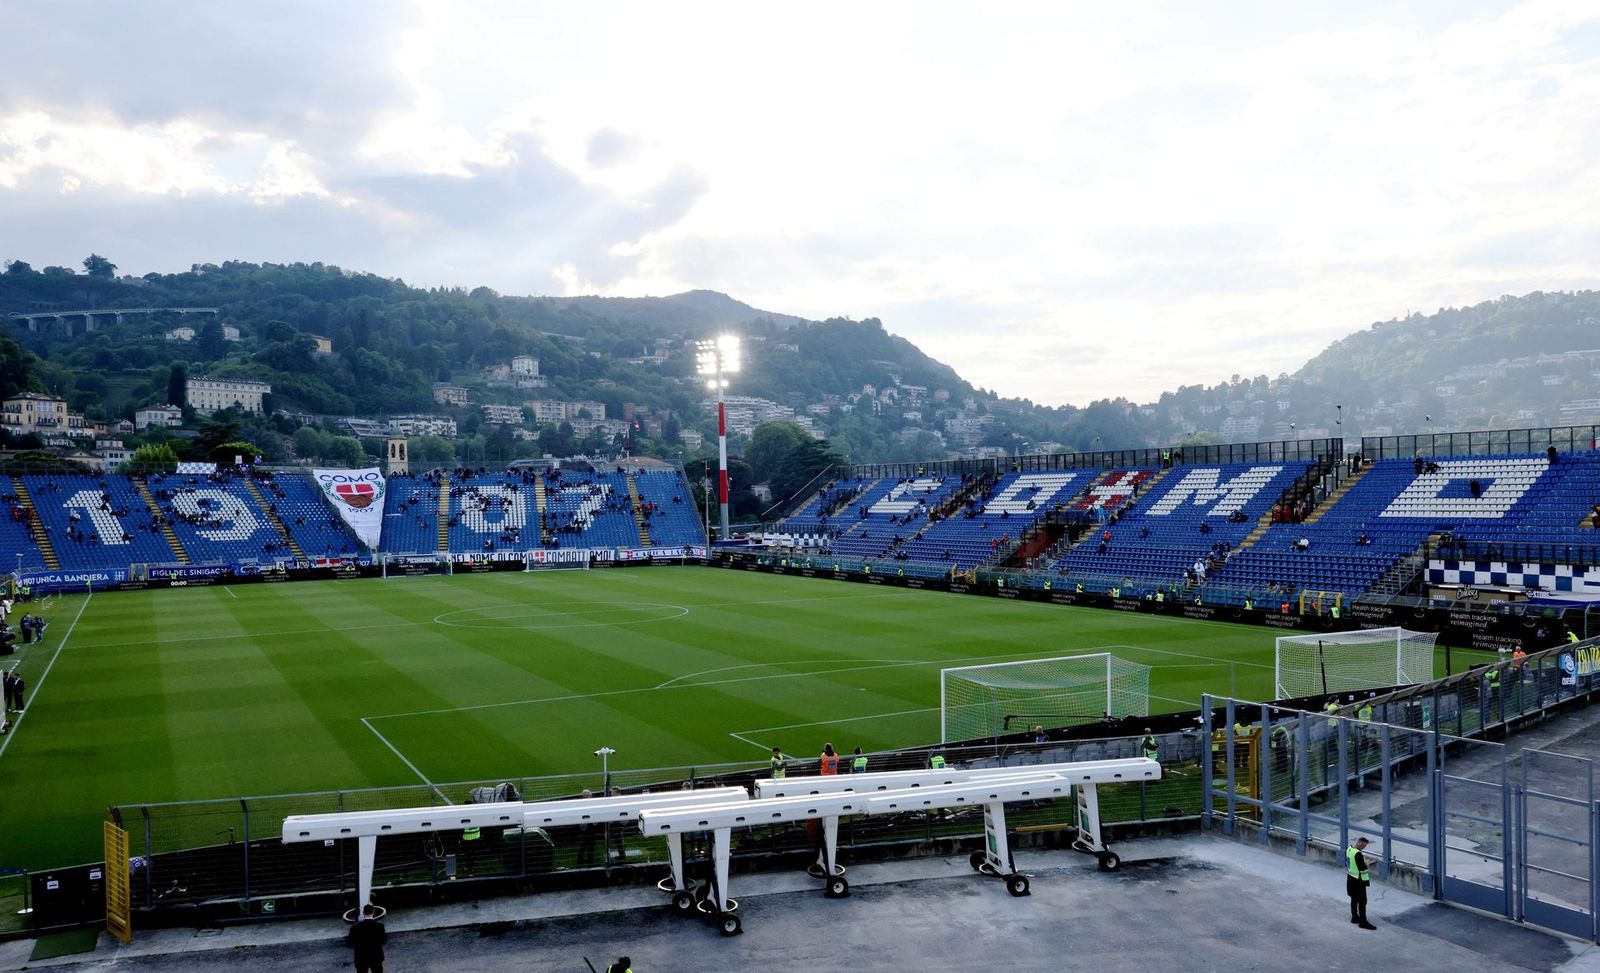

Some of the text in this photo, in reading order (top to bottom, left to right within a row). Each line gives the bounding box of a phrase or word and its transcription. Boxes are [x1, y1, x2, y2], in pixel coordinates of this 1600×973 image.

[319, 472, 379, 482] COMO
[36, 575, 62, 583] UNICA
[64, 573, 109, 582] BANDIERA
[1472, 633, 1494, 641] Health
